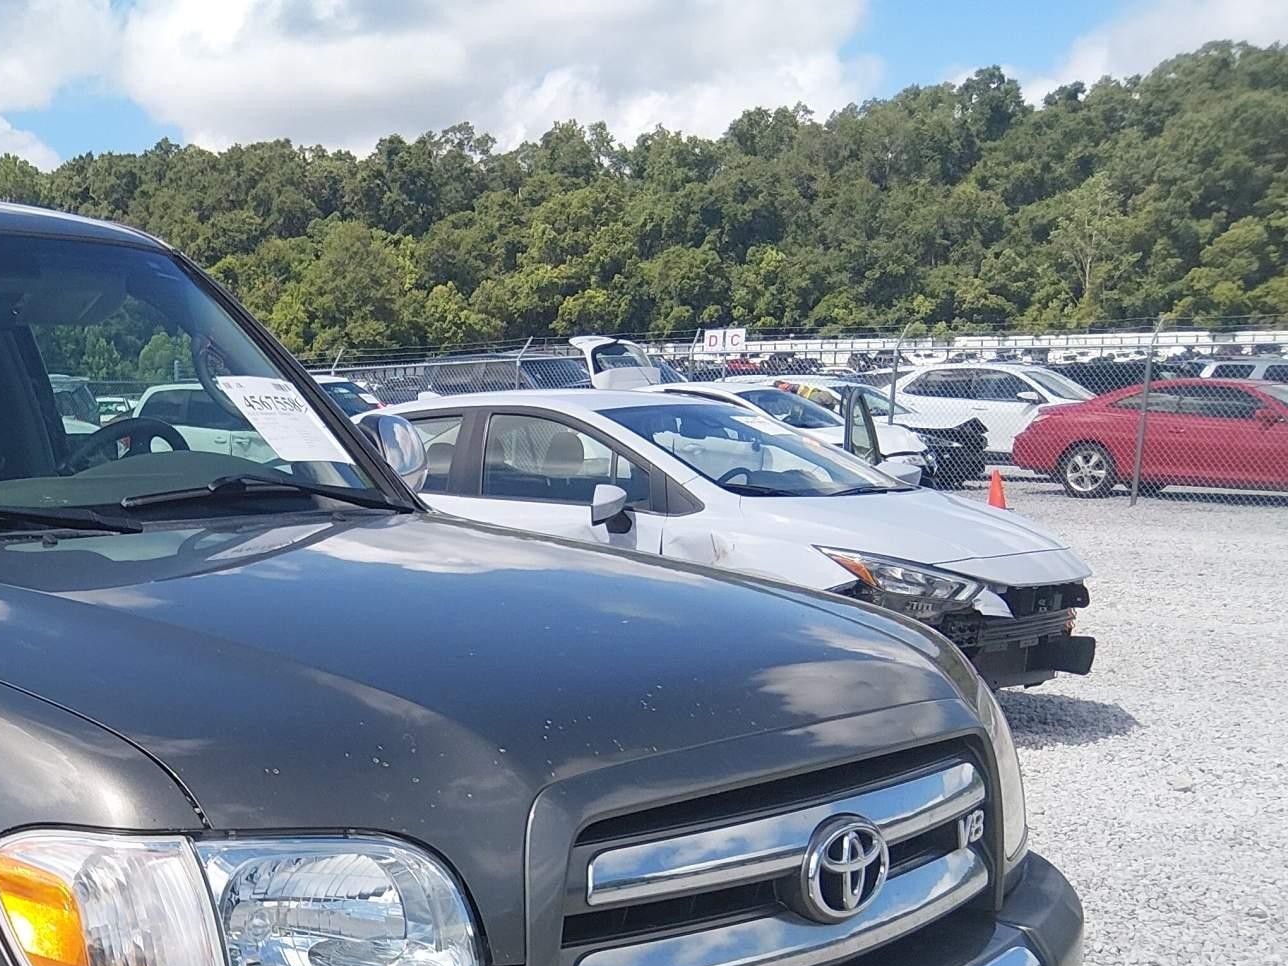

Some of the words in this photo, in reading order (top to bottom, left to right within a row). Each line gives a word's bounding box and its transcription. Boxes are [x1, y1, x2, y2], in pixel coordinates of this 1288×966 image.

[709, 335, 718, 347] D
[730, 334, 740, 346] C
[958, 809, 985, 849] V8
